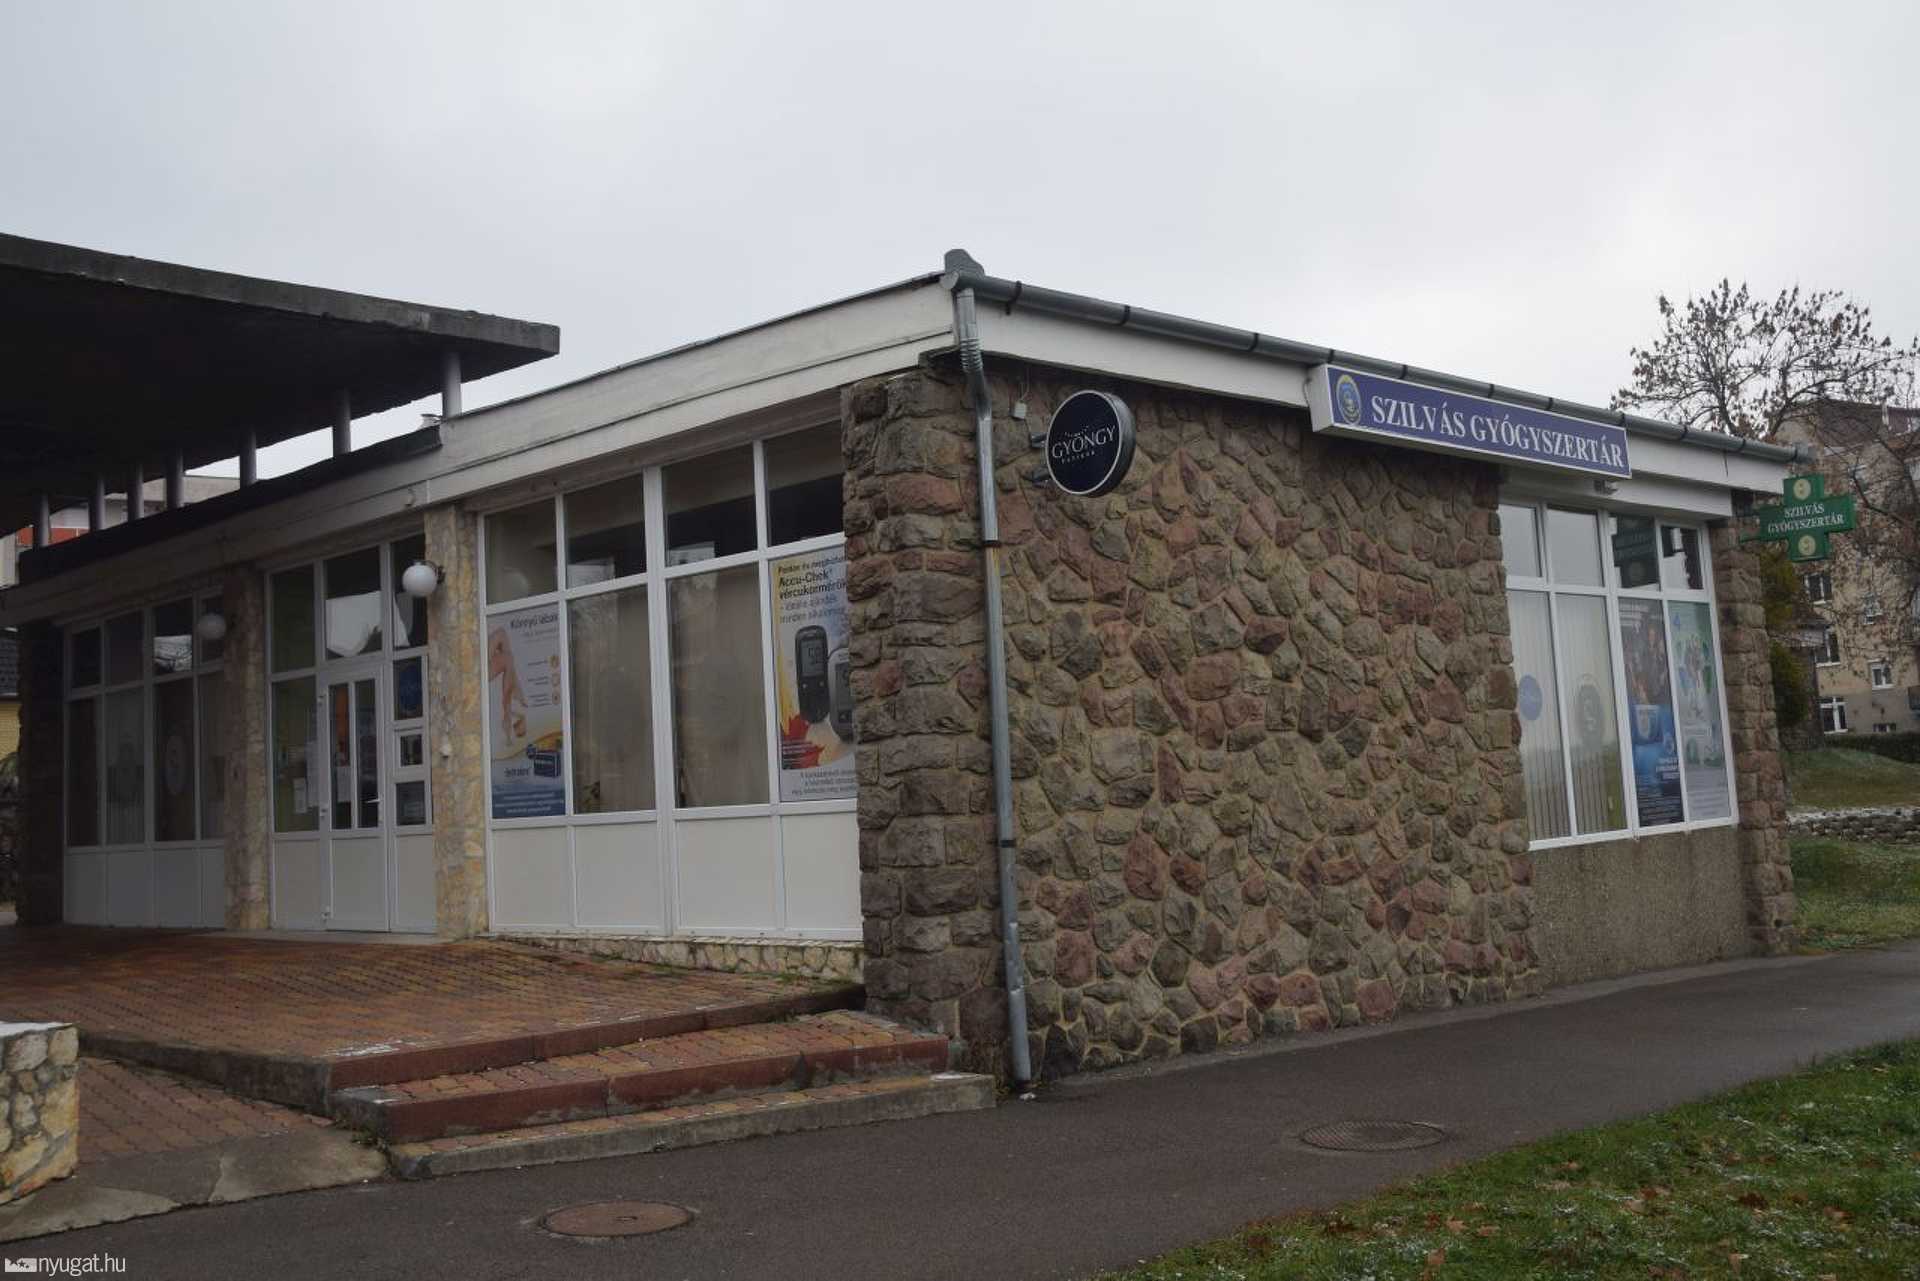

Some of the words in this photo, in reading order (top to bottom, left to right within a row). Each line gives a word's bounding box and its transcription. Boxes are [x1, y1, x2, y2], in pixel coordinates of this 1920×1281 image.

[1371, 395, 1466, 437] SZILVÁS
[1470, 414, 1623, 468] GYÓGYSZERTÁR
[1784, 502, 1824, 518] SZILVÁS
[1768, 512, 1844, 533] GYÓGYSZERTÁR
